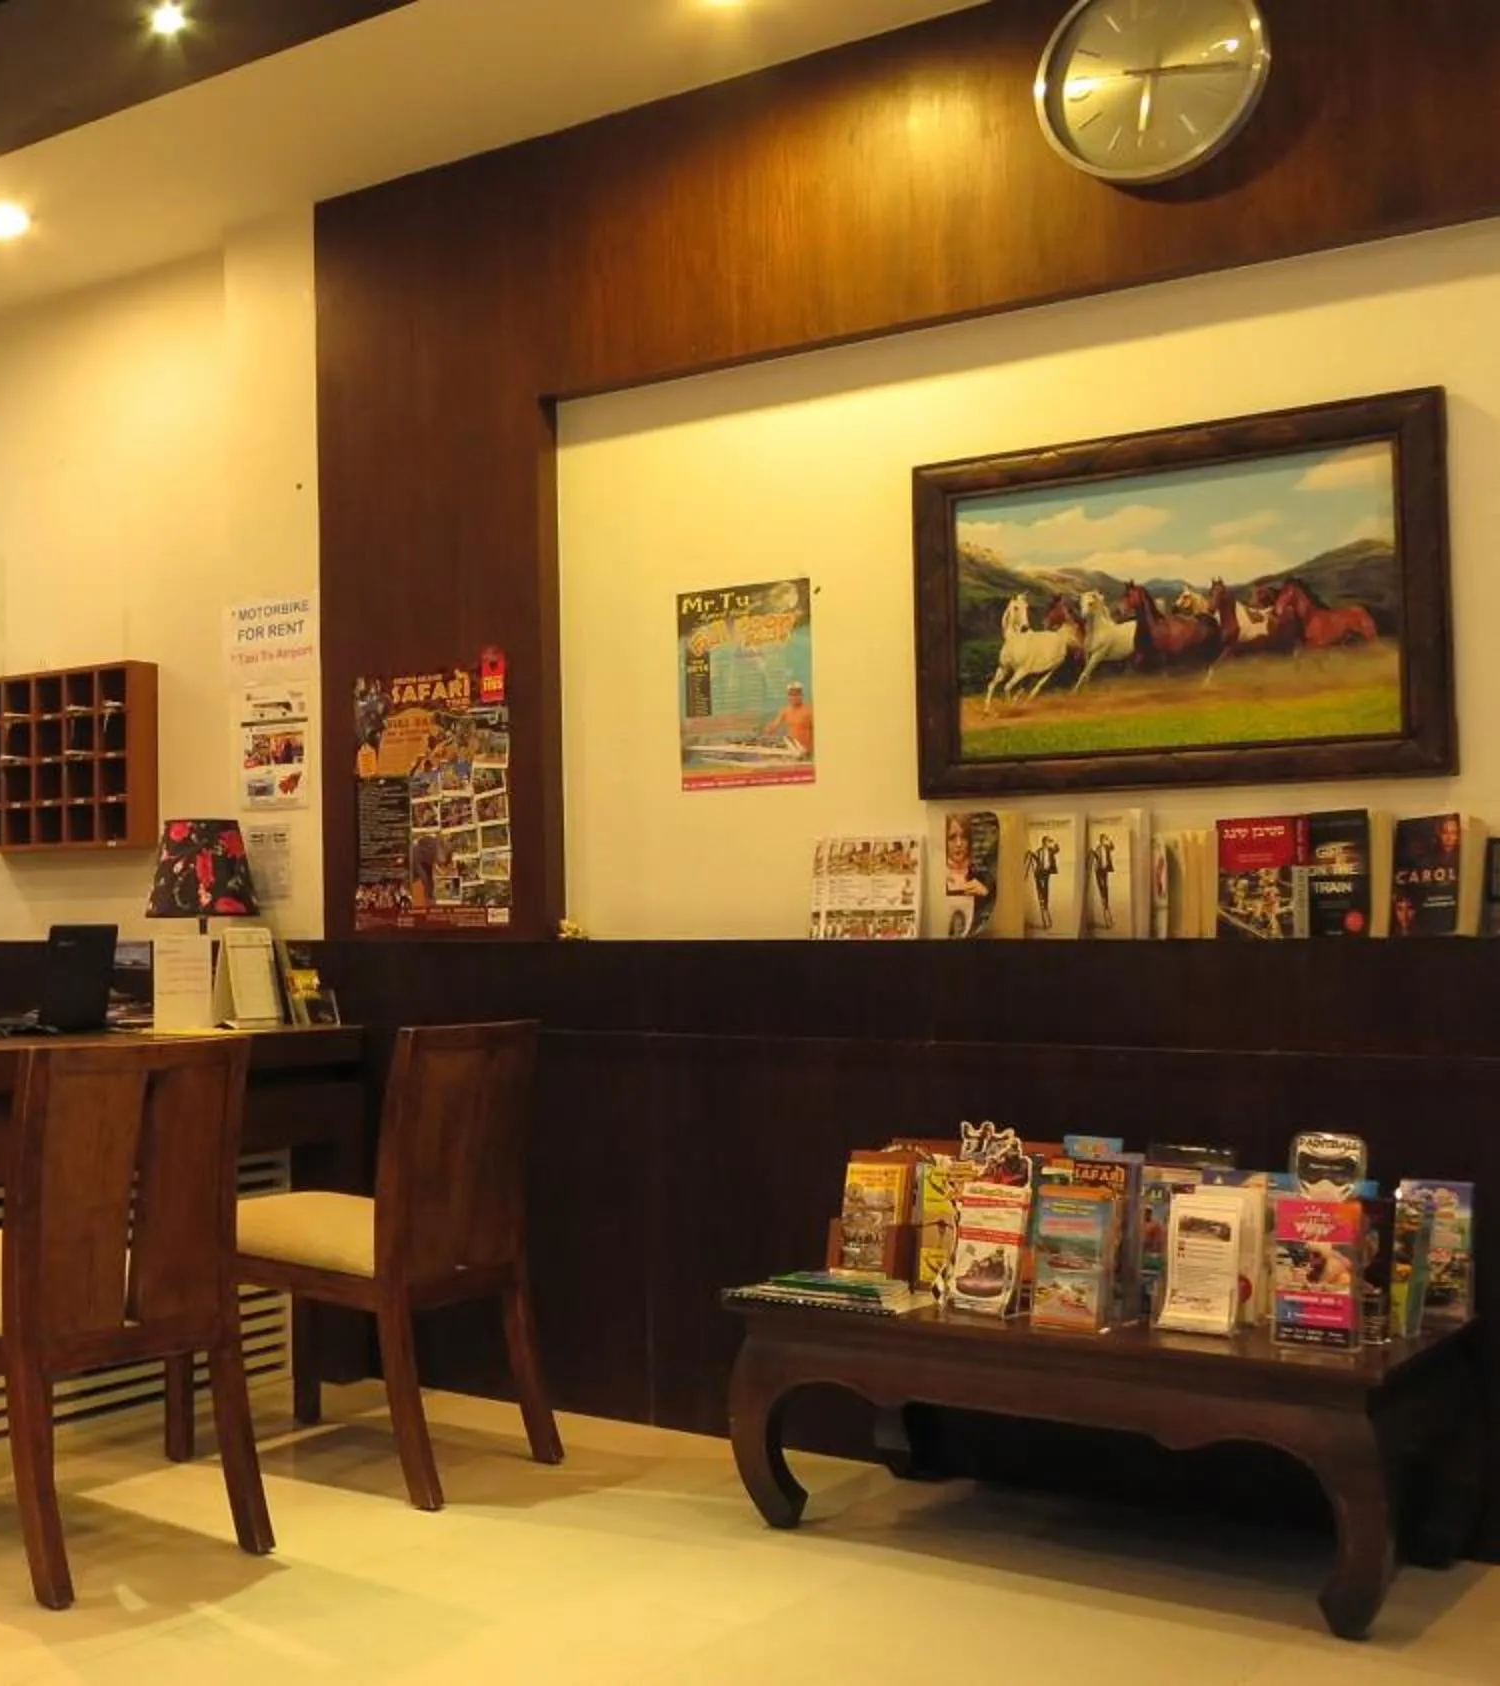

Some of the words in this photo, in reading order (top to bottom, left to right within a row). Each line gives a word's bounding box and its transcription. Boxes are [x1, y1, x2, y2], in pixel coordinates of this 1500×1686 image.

[238, 600, 309, 621] MOTORBIKE
[237, 625, 265, 642] FOR
[267, 620, 304, 638] RENT
[391, 671, 470, 704] SAFARI
[1395, 867, 1457, 885] CAROL
[1314, 881, 1353, 894] TRAIN
